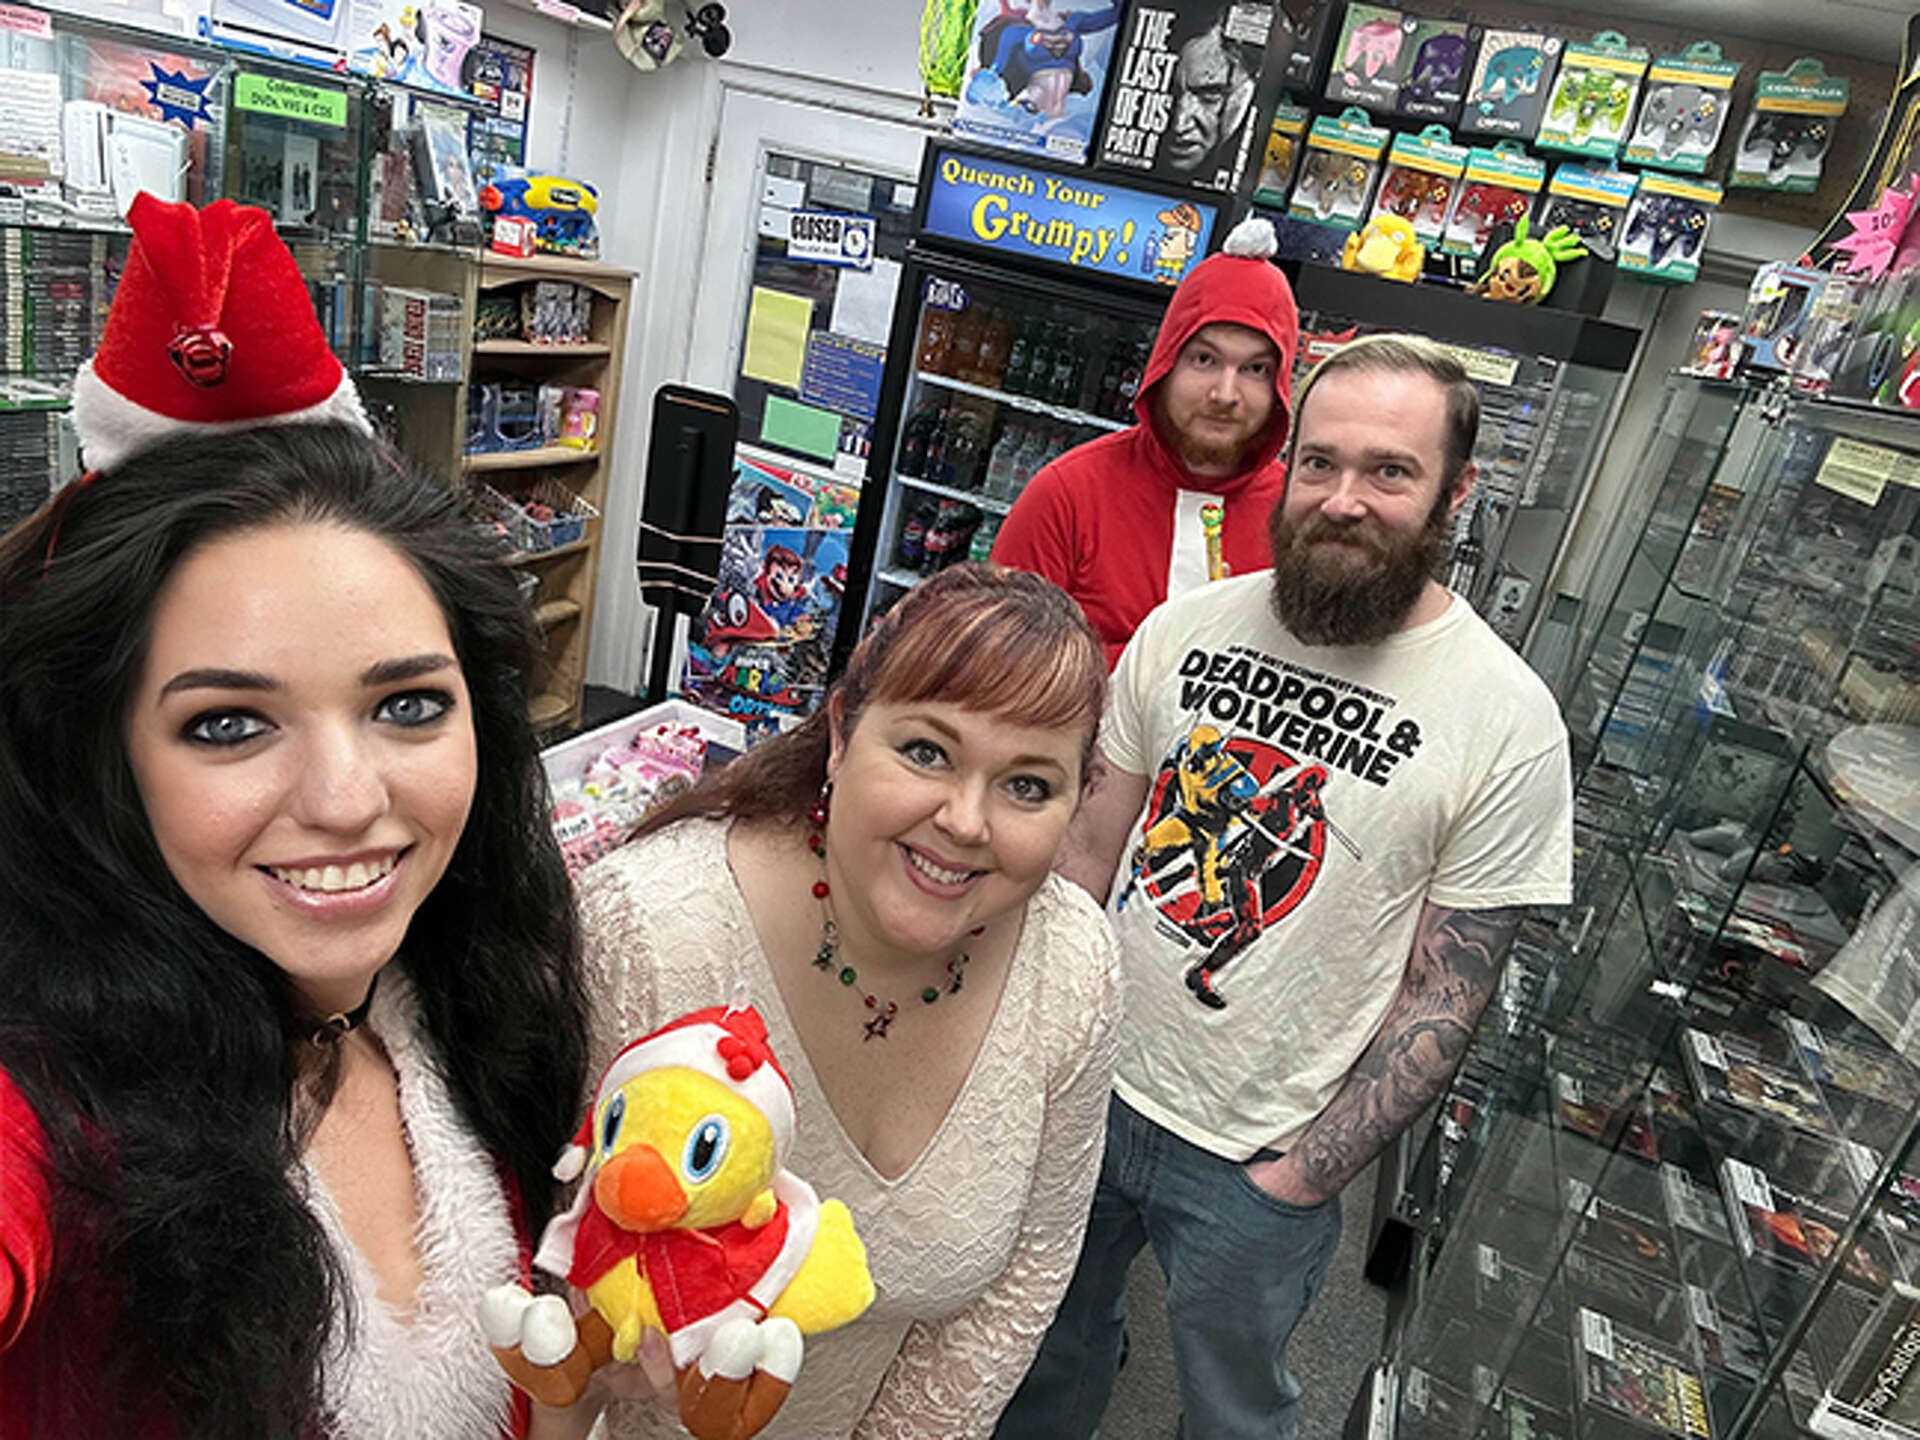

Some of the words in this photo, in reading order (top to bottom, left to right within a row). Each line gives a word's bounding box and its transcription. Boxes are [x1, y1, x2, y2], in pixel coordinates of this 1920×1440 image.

[1138, 8, 1177, 51] THE
[1120, 47, 1179, 92] LAST
[1112, 87, 1143, 126] OF
[1138, 92, 1173, 133] US
[1105, 126, 1146, 155] PART
[942, 158, 1035, 196] Quench
[1045, 178, 1106, 209] Your
[791, 215, 841, 243] CLOSED
[971, 194, 1136, 265] Grumpy!
[1179, 648, 1386, 741] DEADPOOL
[1386, 719, 1422, 758] &
[1179, 680, 1400, 787] WOLVERINE
